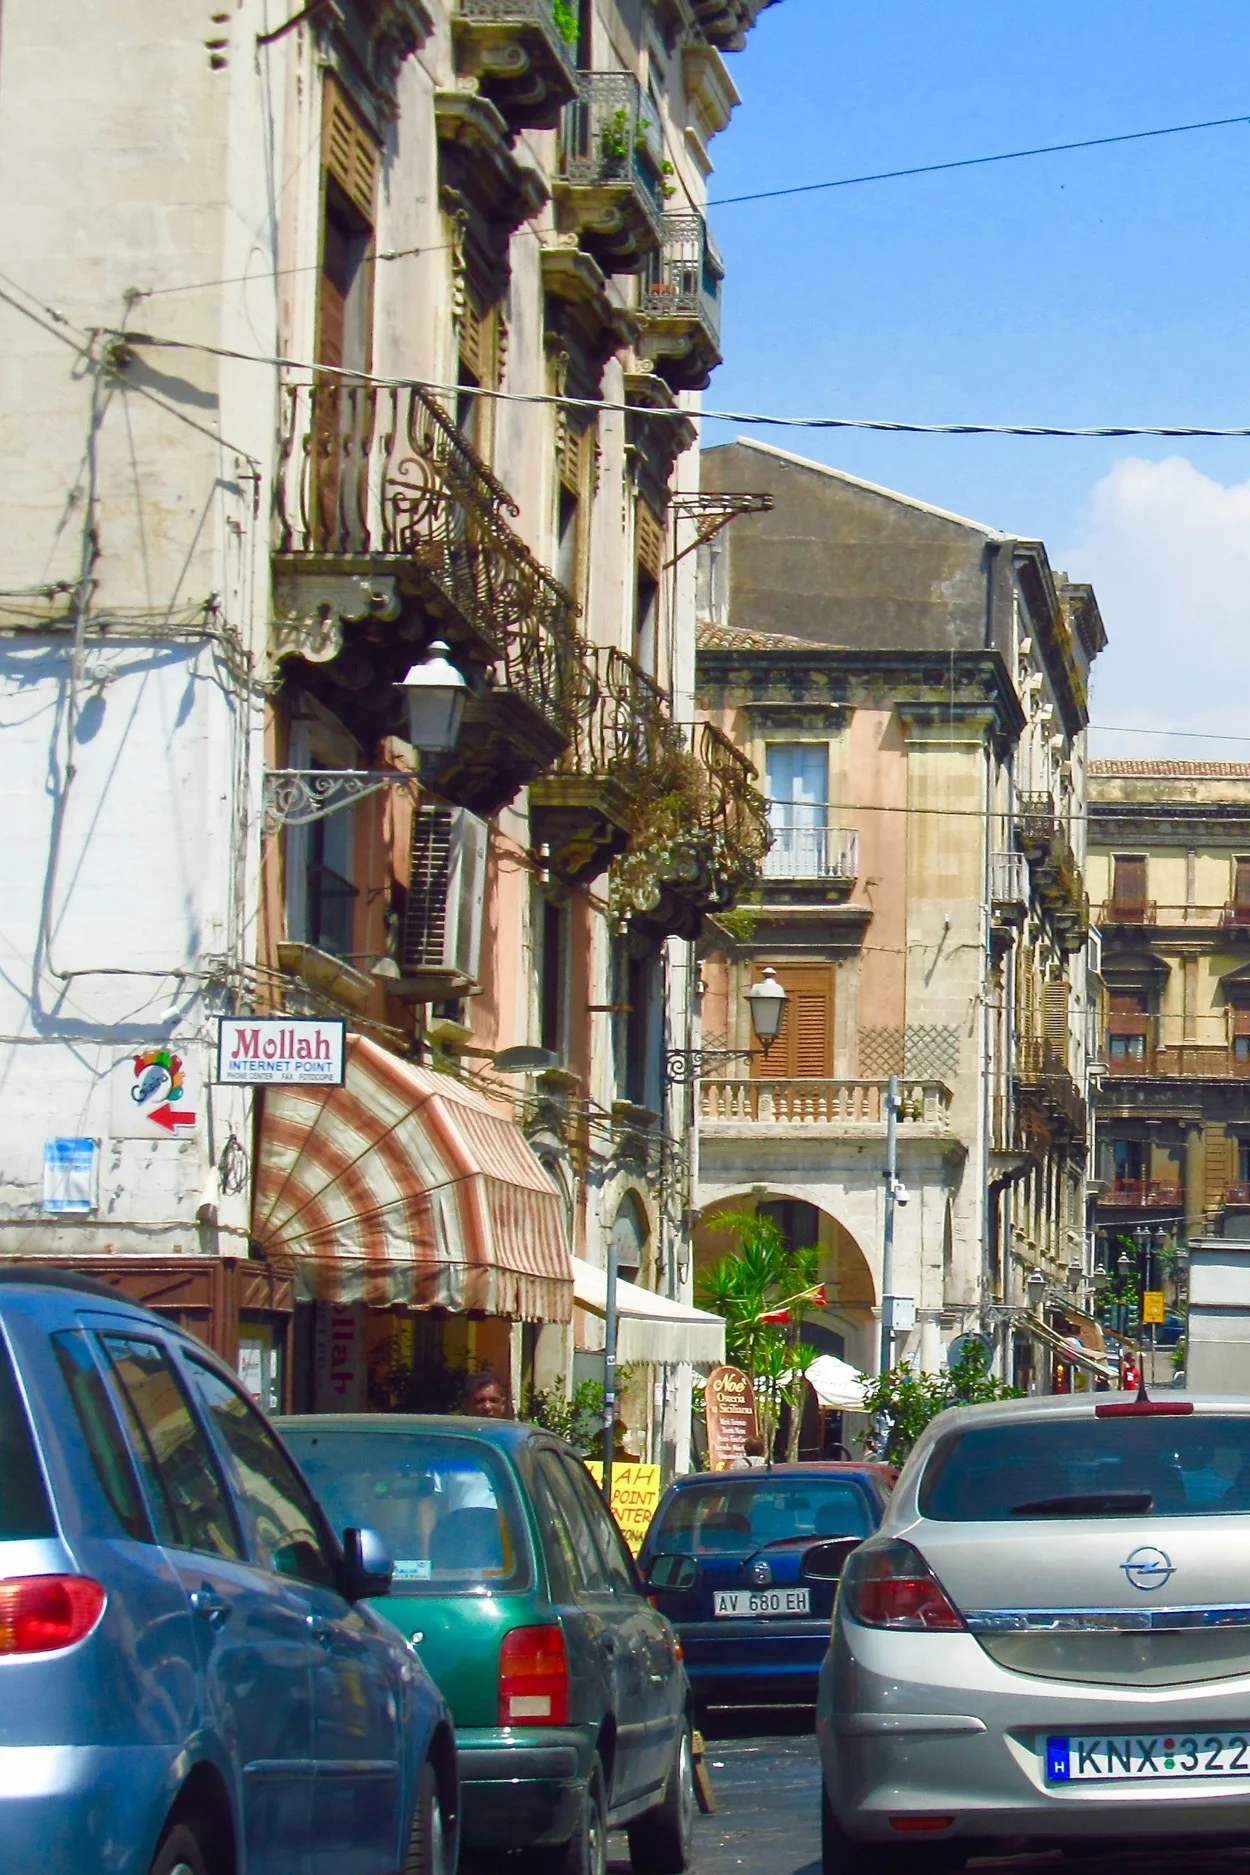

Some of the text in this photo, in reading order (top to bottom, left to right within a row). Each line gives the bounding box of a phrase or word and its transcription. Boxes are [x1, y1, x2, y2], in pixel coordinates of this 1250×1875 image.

[231, 1028, 331, 1059] Mollah
[229, 1061, 333, 1072] INTERNET POINT
[613, 1489, 656, 1506] POINT
[719, 1593, 806, 1612] AV 680 EH
[1054, 1762, 1065, 1773] H
